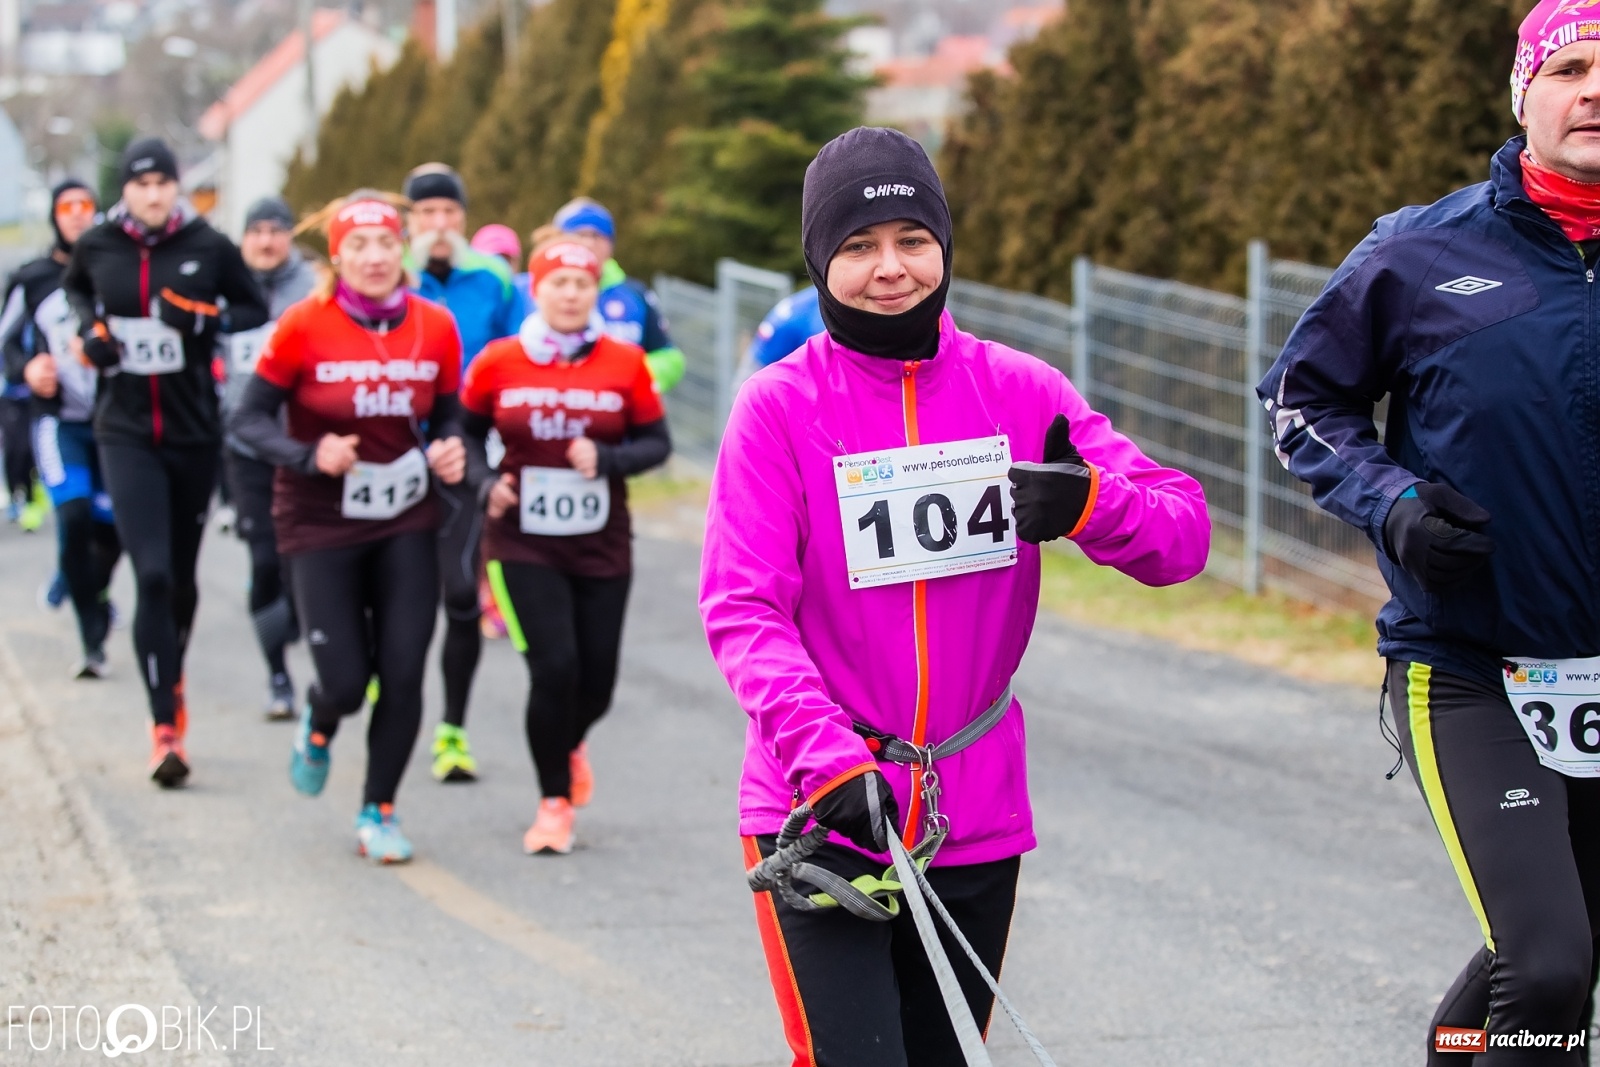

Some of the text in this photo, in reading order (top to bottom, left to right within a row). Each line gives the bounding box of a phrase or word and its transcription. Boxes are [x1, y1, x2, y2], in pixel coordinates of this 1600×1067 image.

[1540, 21, 1578, 61] XIII
[876, 184, 916, 197] HI-TEC
[902, 451, 1005, 473] www.personalbest.pl
[351, 475, 422, 506] 412
[528, 491, 600, 518] 409
[857, 484, 1010, 559] 104
[1521, 700, 1600, 755] 36
[1500, 797, 1541, 810] Kalenji
